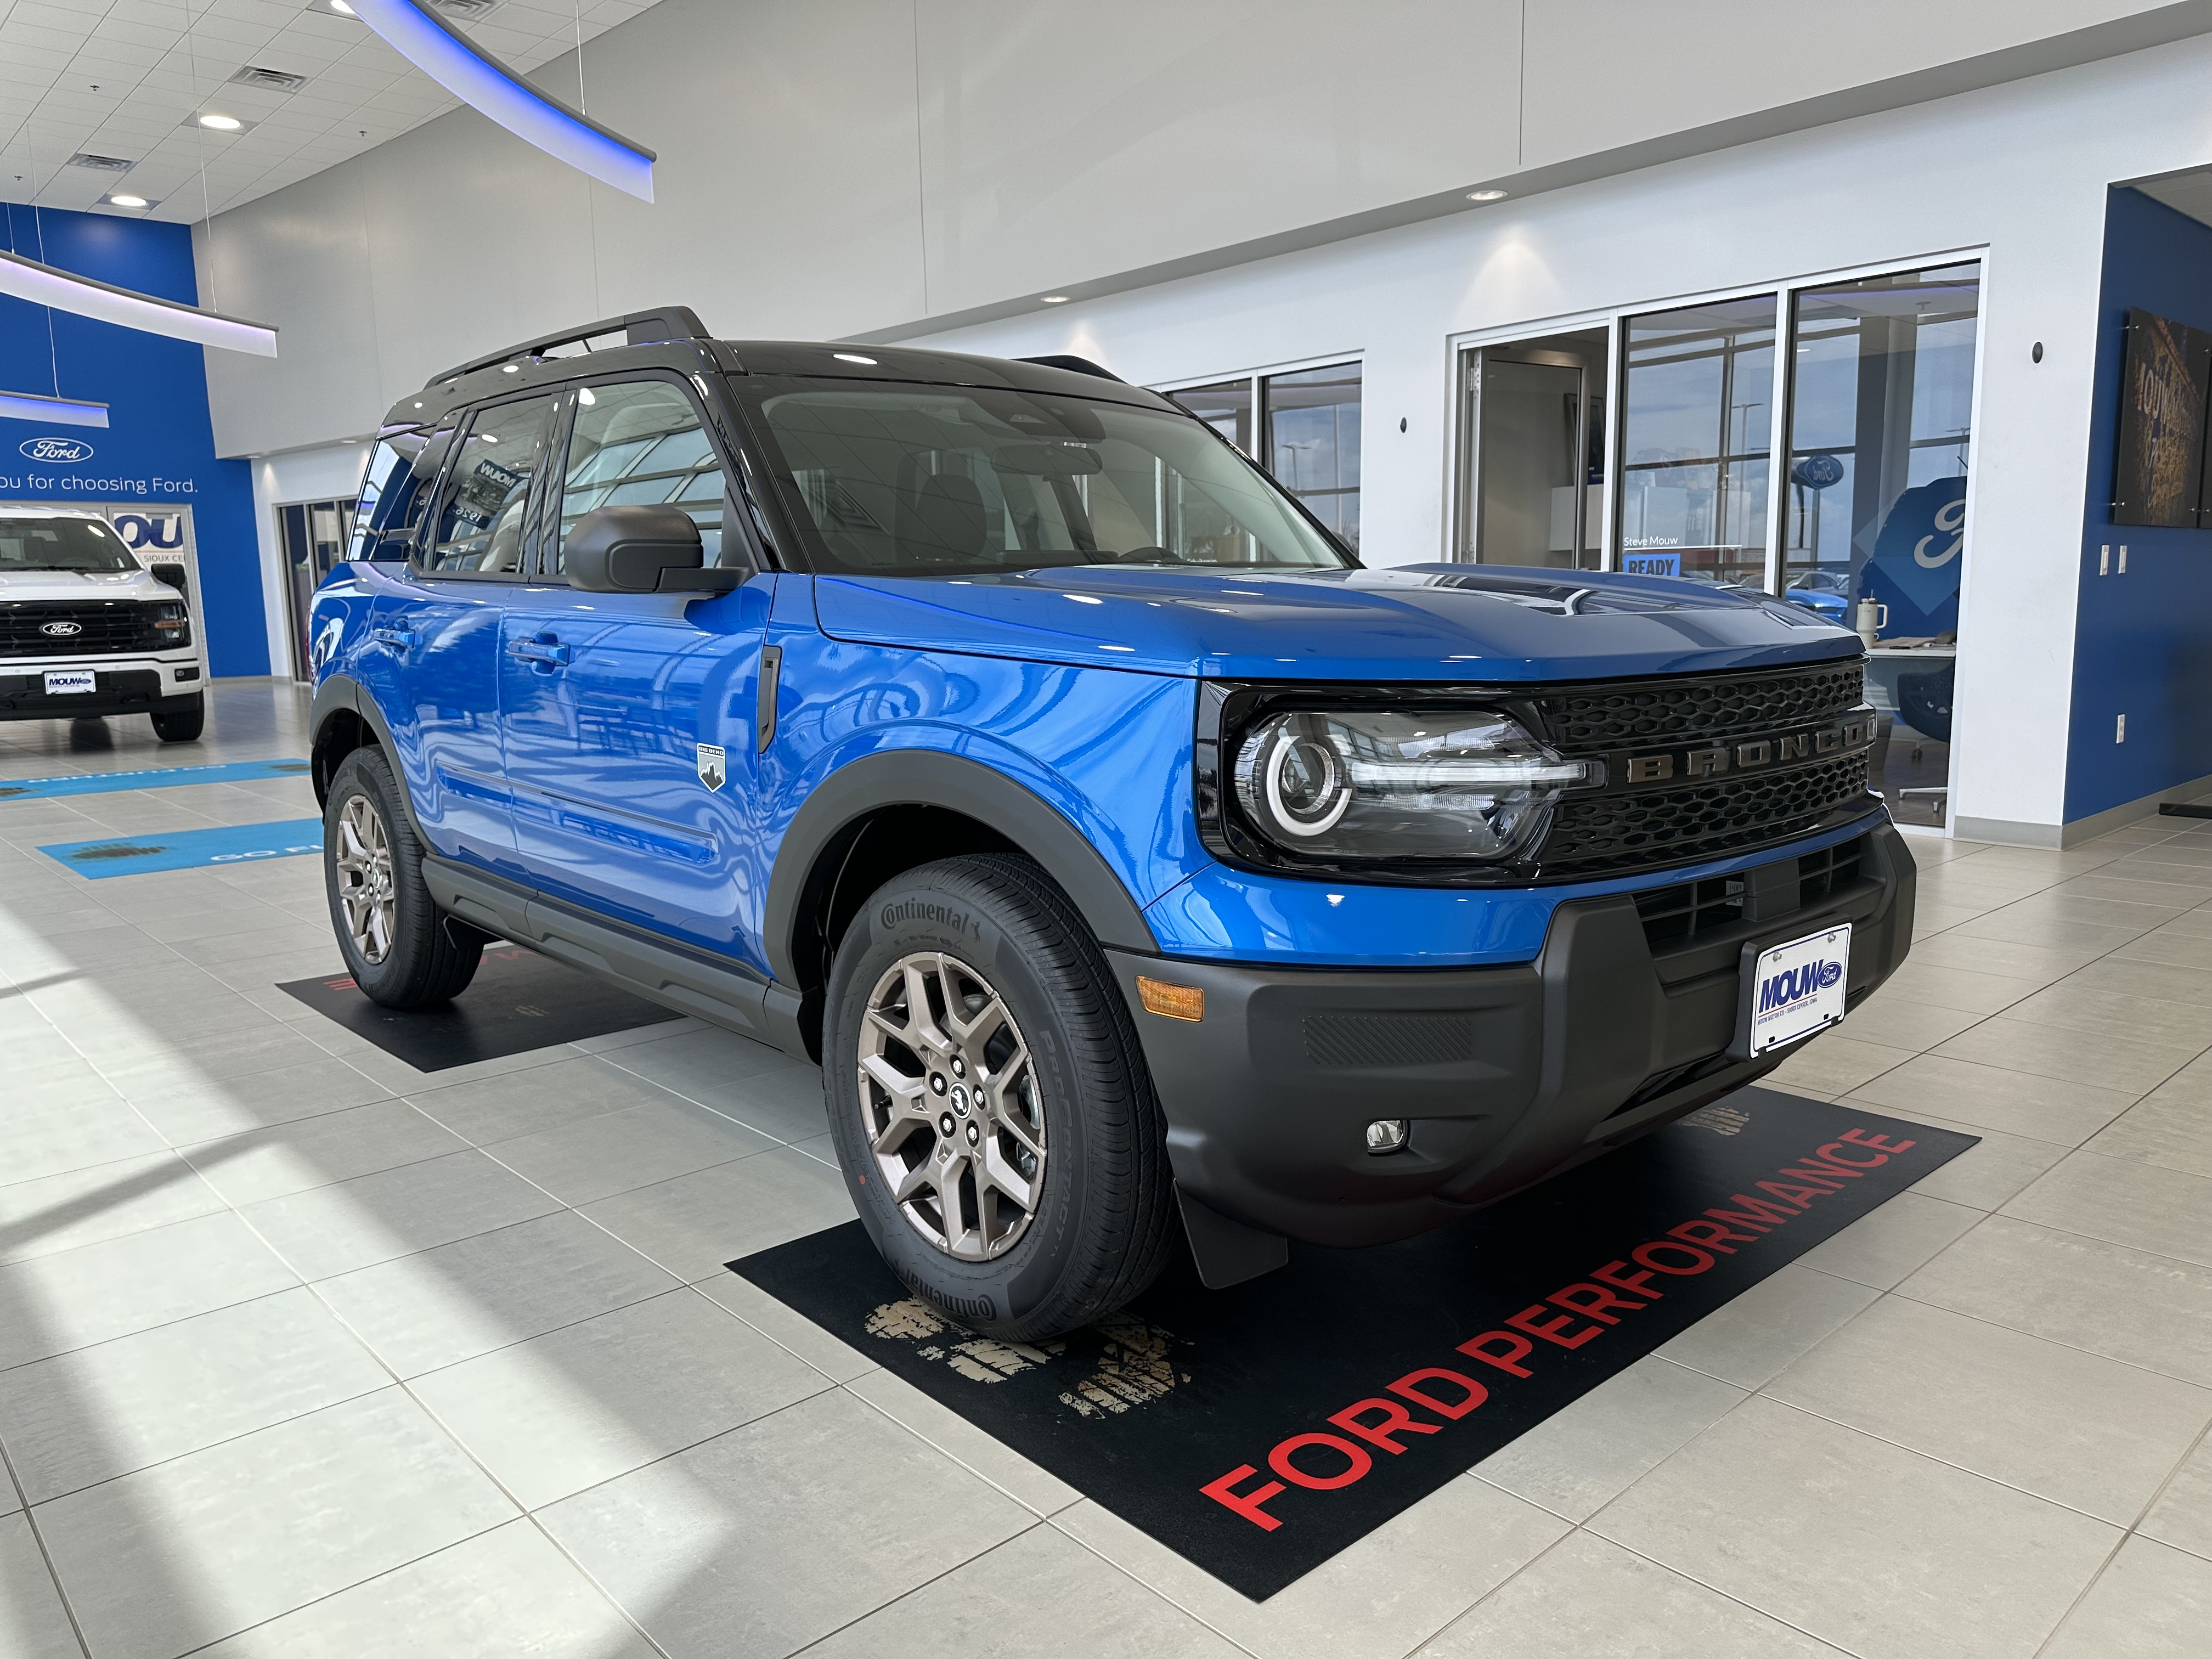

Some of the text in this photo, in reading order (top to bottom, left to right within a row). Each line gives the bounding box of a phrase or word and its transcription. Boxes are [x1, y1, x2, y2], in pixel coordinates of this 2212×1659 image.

[33, 440, 81, 459] Ford
[27, 473, 55, 489] for
[61, 475, 148, 494] choosing
[152, 477, 198, 493] Ford.
[1624, 535, 1678, 546] Steve Mouw
[1628, 559, 1674, 576] READY
[50, 623, 75, 633] Ford
[49, 678, 81, 686] MOUW
[1626, 722, 1864, 784] BRONCO
[210, 850, 277, 861] GO
[881, 897, 970, 934] Continental
[1758, 958, 1838, 1014] MOUW Ford
[1768, 1012, 1779, 1022] MOTOR
[906, 1267, 997, 1322] Continental
[1199, 1127, 1917, 1532] FORD PERFORMANCE
